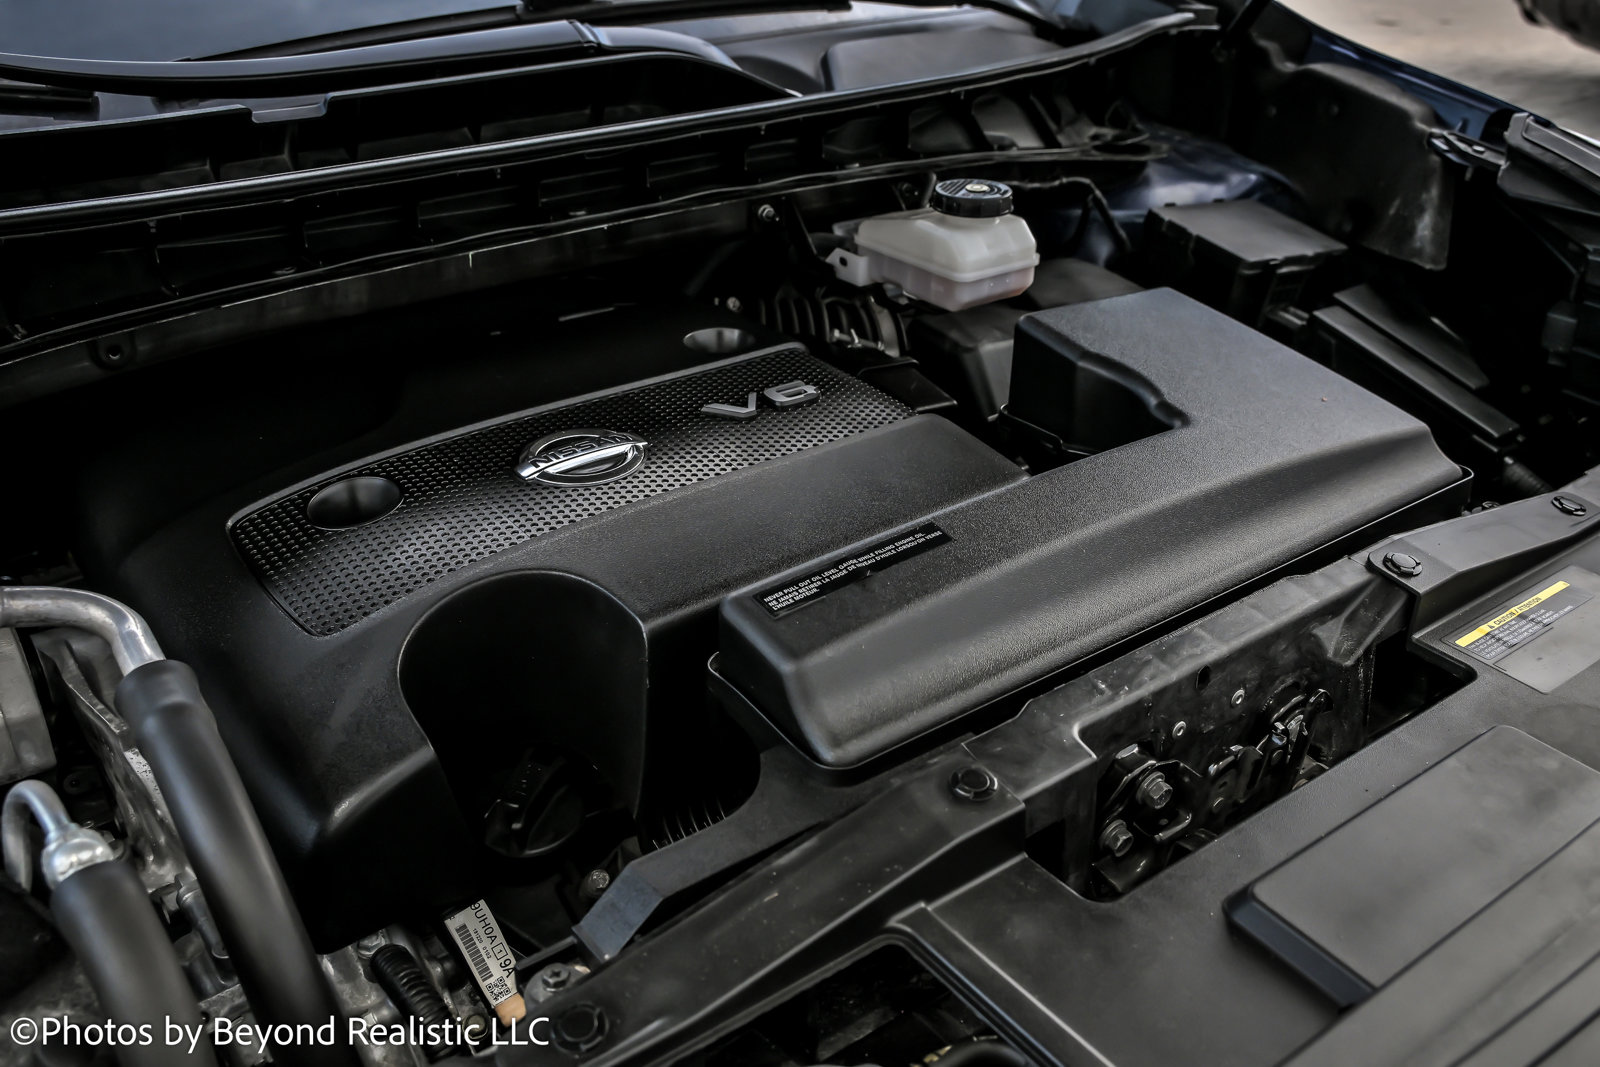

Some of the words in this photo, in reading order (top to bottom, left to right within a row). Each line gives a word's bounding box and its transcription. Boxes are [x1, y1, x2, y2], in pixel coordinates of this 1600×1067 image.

[701, 380, 820, 418] V6
[528, 433, 633, 469] NISSAN
[763, 590, 784, 603] NEVER
[783, 584, 800, 594] PULL
[798, 578, 812, 588] OUT
[811, 574, 823, 582] OIL
[821, 567, 839, 578] LEVEL
[838, 558, 859, 570] GAUGE
[857, 552, 876, 562] WHILE
[874, 543, 896, 556] FILLING
[894, 536, 916, 547] ENGINE
[768, 599, 779, 607] NE
[778, 590, 799, 603] JAMAIS
[797, 580, 823, 594] RETIRER
[830, 569, 849, 581] JAUGE
[855, 557, 876, 568] NIVEAU
[875, 549, 897, 561] D'HUILE
[924, 530, 943, 540] VERSE
[772, 598, 795, 611] L'HUILE
[1493, 611, 1516, 626] CAUTION
[500, 959, 515, 978] 9A
